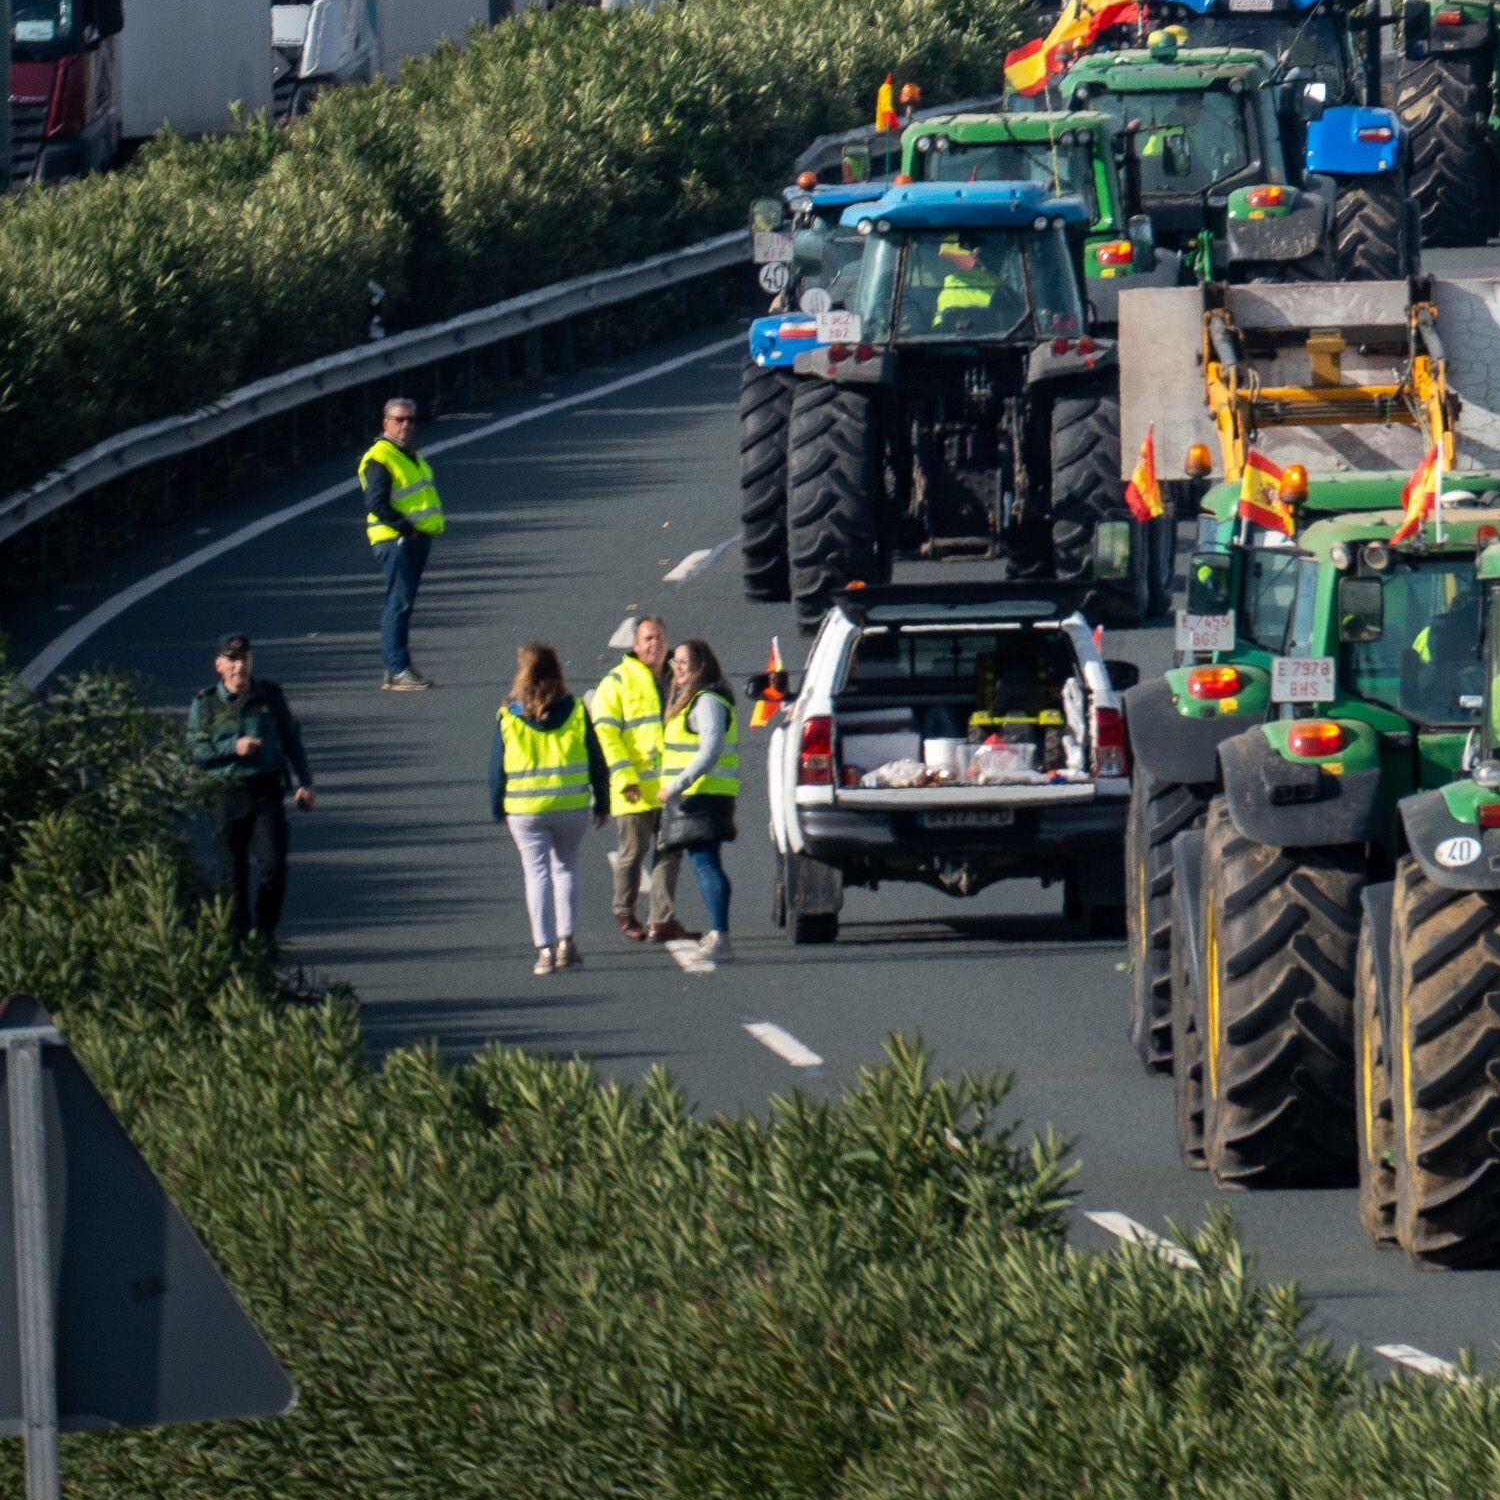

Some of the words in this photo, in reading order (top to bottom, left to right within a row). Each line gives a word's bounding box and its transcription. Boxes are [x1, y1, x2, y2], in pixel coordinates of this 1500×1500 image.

[762, 264, 786, 289] 40
[1278, 662, 1286, 677] E
[1446, 840, 1472, 862] 40
